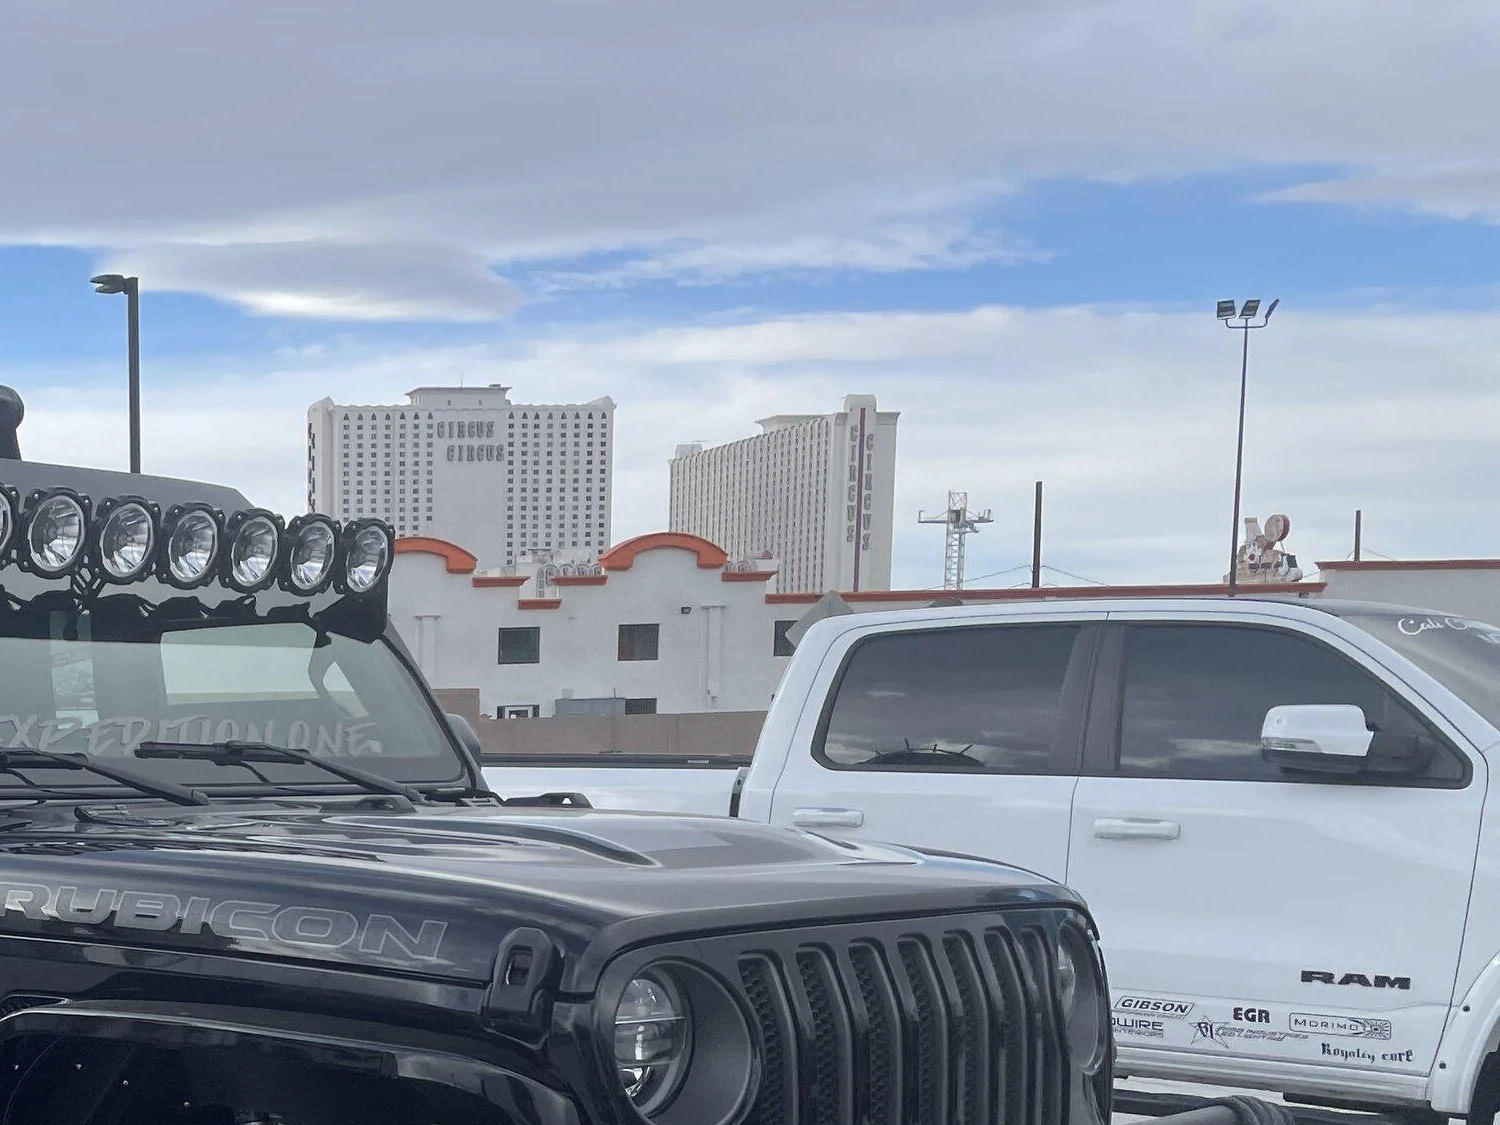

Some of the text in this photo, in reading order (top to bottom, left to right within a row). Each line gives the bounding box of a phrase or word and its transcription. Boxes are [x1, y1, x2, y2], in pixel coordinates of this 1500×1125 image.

[437, 421, 494, 438] CIRCUS
[446, 444, 505, 462] CIRCUS
[1301, 970, 1411, 990] RAM
[1121, 998, 1189, 1014] GIBSON
[1232, 1006, 1271, 1024] EGR
